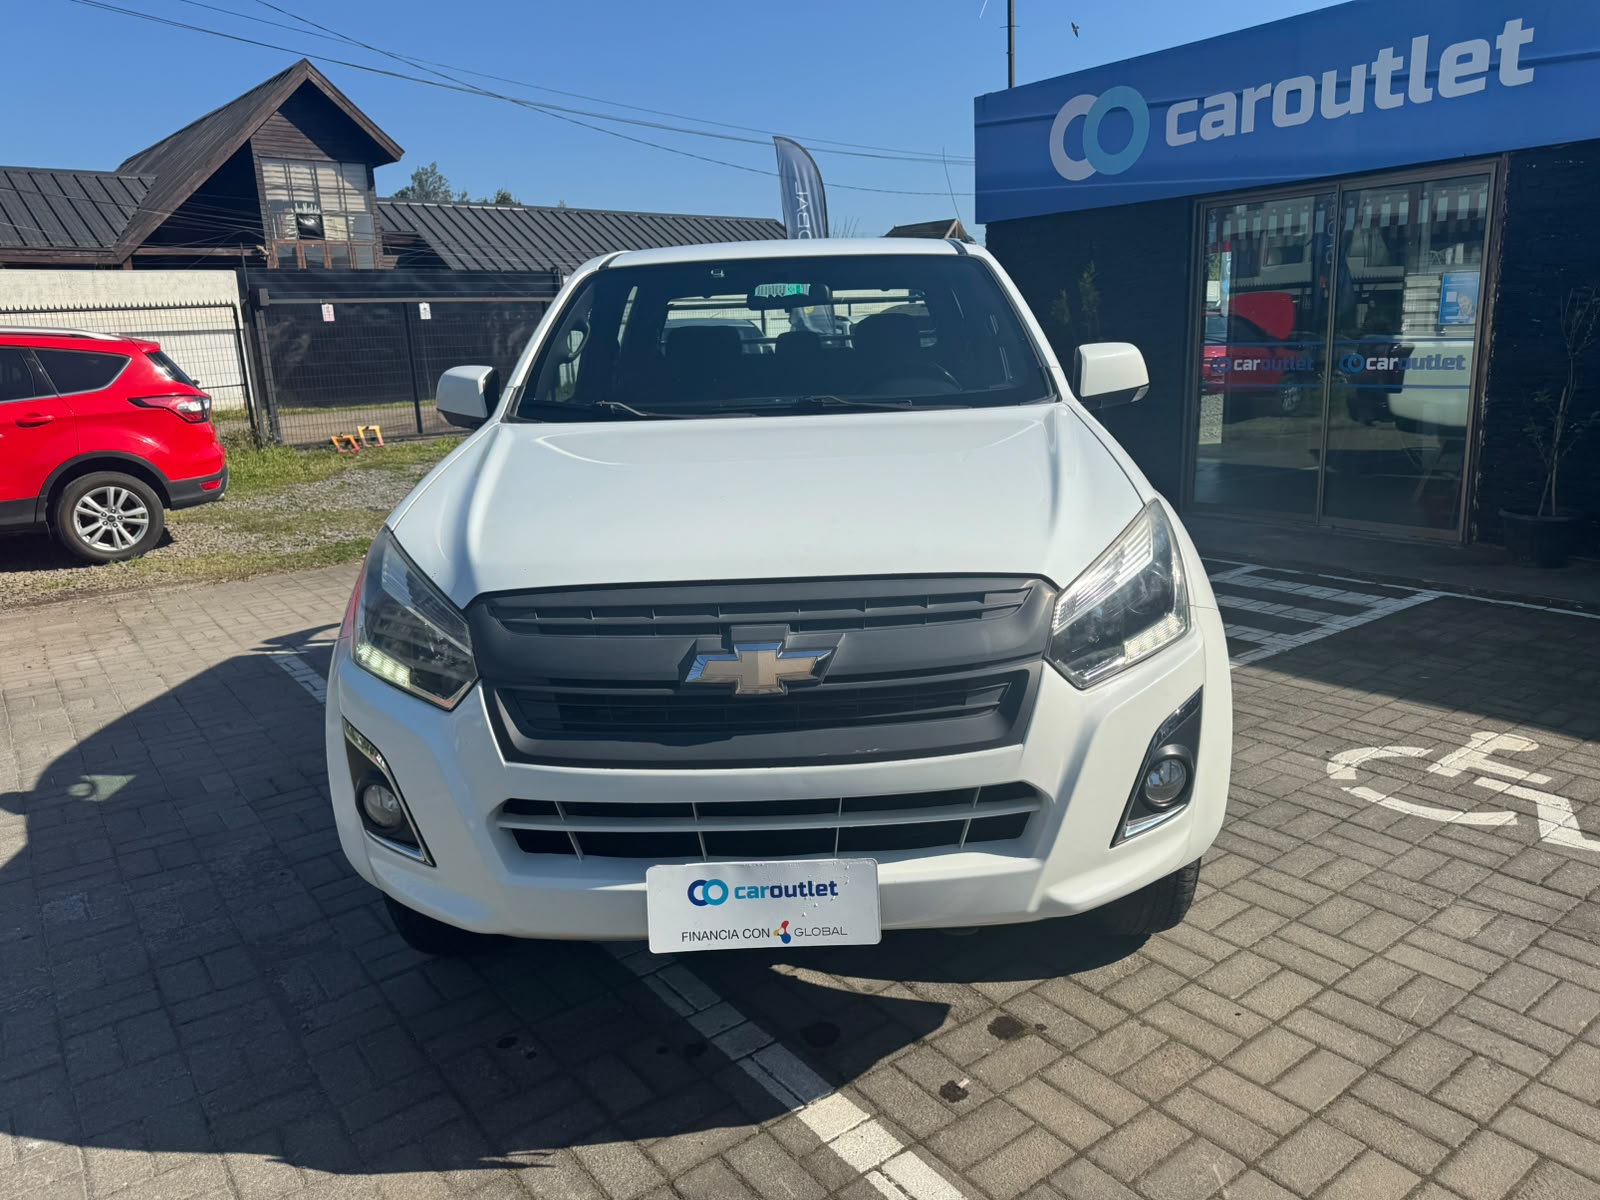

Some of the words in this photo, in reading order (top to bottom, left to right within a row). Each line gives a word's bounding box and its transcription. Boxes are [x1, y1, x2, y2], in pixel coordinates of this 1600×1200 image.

[1165, 18, 1535, 147] caroutlet
[1233, 356, 1314, 371] caroutlet
[1366, 354, 1466, 371] caroutlet
[734, 880, 839, 900] caroutlet
[681, 929, 740, 943] FINANCIA
[742, 928, 770, 939] CON
[794, 926, 848, 938] GLOBAL
